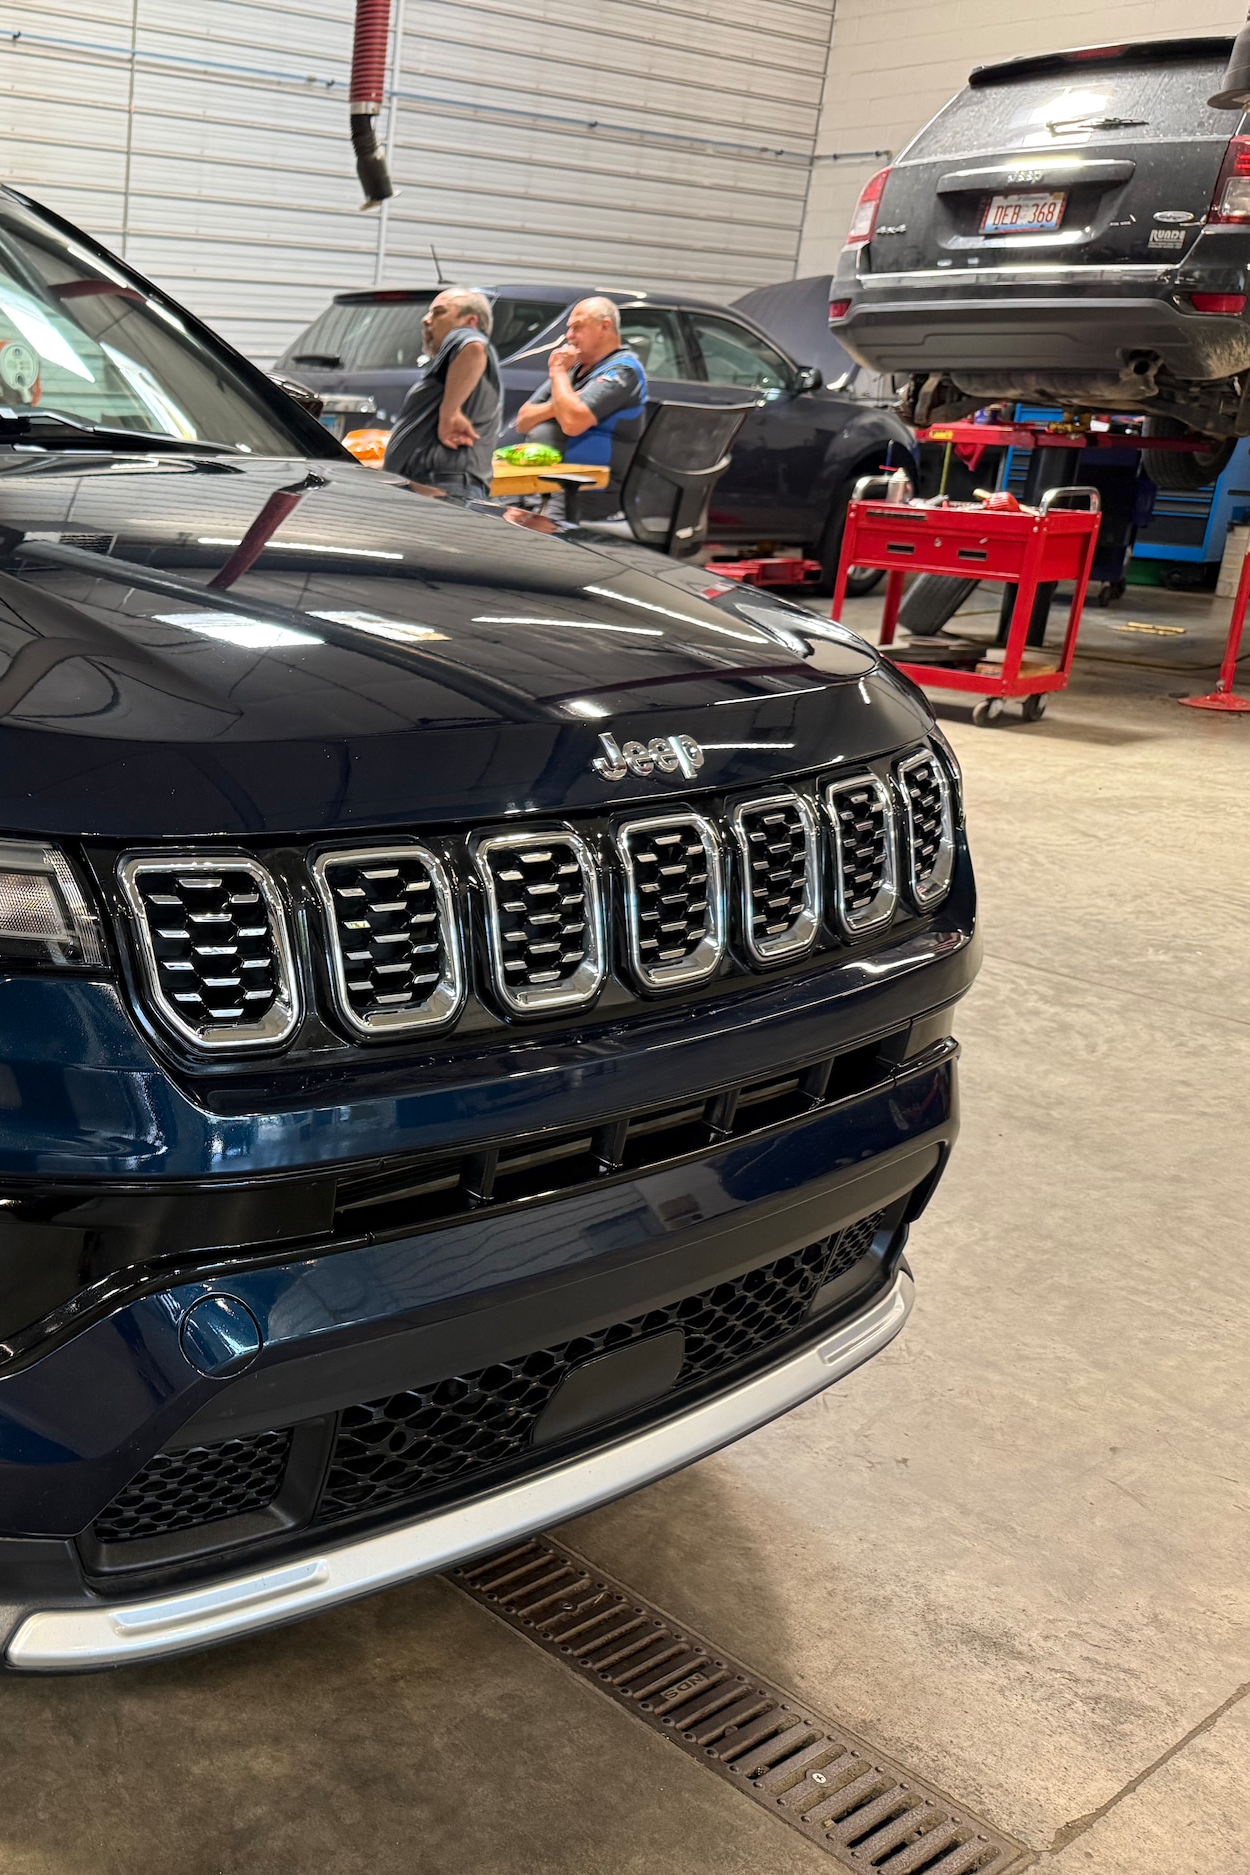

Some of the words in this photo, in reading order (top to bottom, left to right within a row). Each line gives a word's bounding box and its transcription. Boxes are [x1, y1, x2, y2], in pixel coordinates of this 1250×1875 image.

[992, 204, 1022, 226] DEB
[1027, 202, 1057, 224] 368
[591, 731, 705, 781] Jeep
[664, 1674, 705, 1699] NDS
